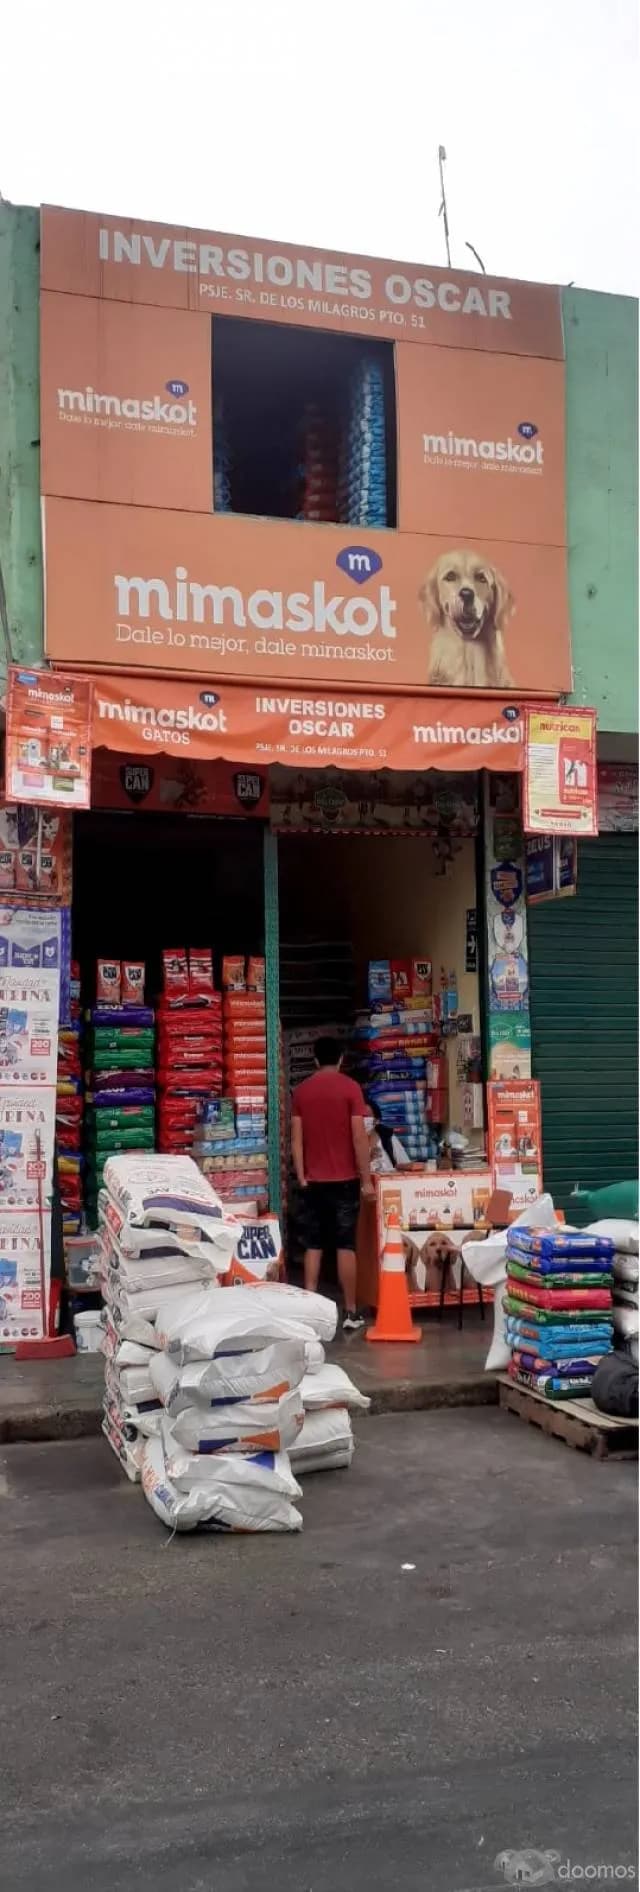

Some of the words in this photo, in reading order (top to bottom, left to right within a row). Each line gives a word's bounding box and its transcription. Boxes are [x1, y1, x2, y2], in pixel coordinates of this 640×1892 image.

[99, 229, 372, 299] INVERSIONES
[385, 274, 512, 319] OSCAR
[199, 283, 232, 299] PSJE.
[235, 288, 255, 304] SR.
[260, 291, 277, 306] DE
[280, 295, 304, 311] LOS
[308, 299, 375, 321] MILAGROS
[411, 315, 426, 329] 51
[58, 386, 197, 426] mimaskot
[423, 431, 544, 465] mimaskot
[348, 553, 371, 571] m
[114, 566, 397, 638] mimaskot
[116, 623, 164, 644] Dale
[167, 628, 186, 646] lo
[190, 633, 249, 655] mejor,
[254, 636, 297, 655] dale
[98, 699, 228, 733] mimaskot
[255, 697, 386, 720] INVERSIONES
[142, 728, 191, 745] GATOS
[289, 719, 355, 738] OSCAR
[414, 1186, 457, 1199] mimaskot
[237, 1239, 278, 1259] CAN
